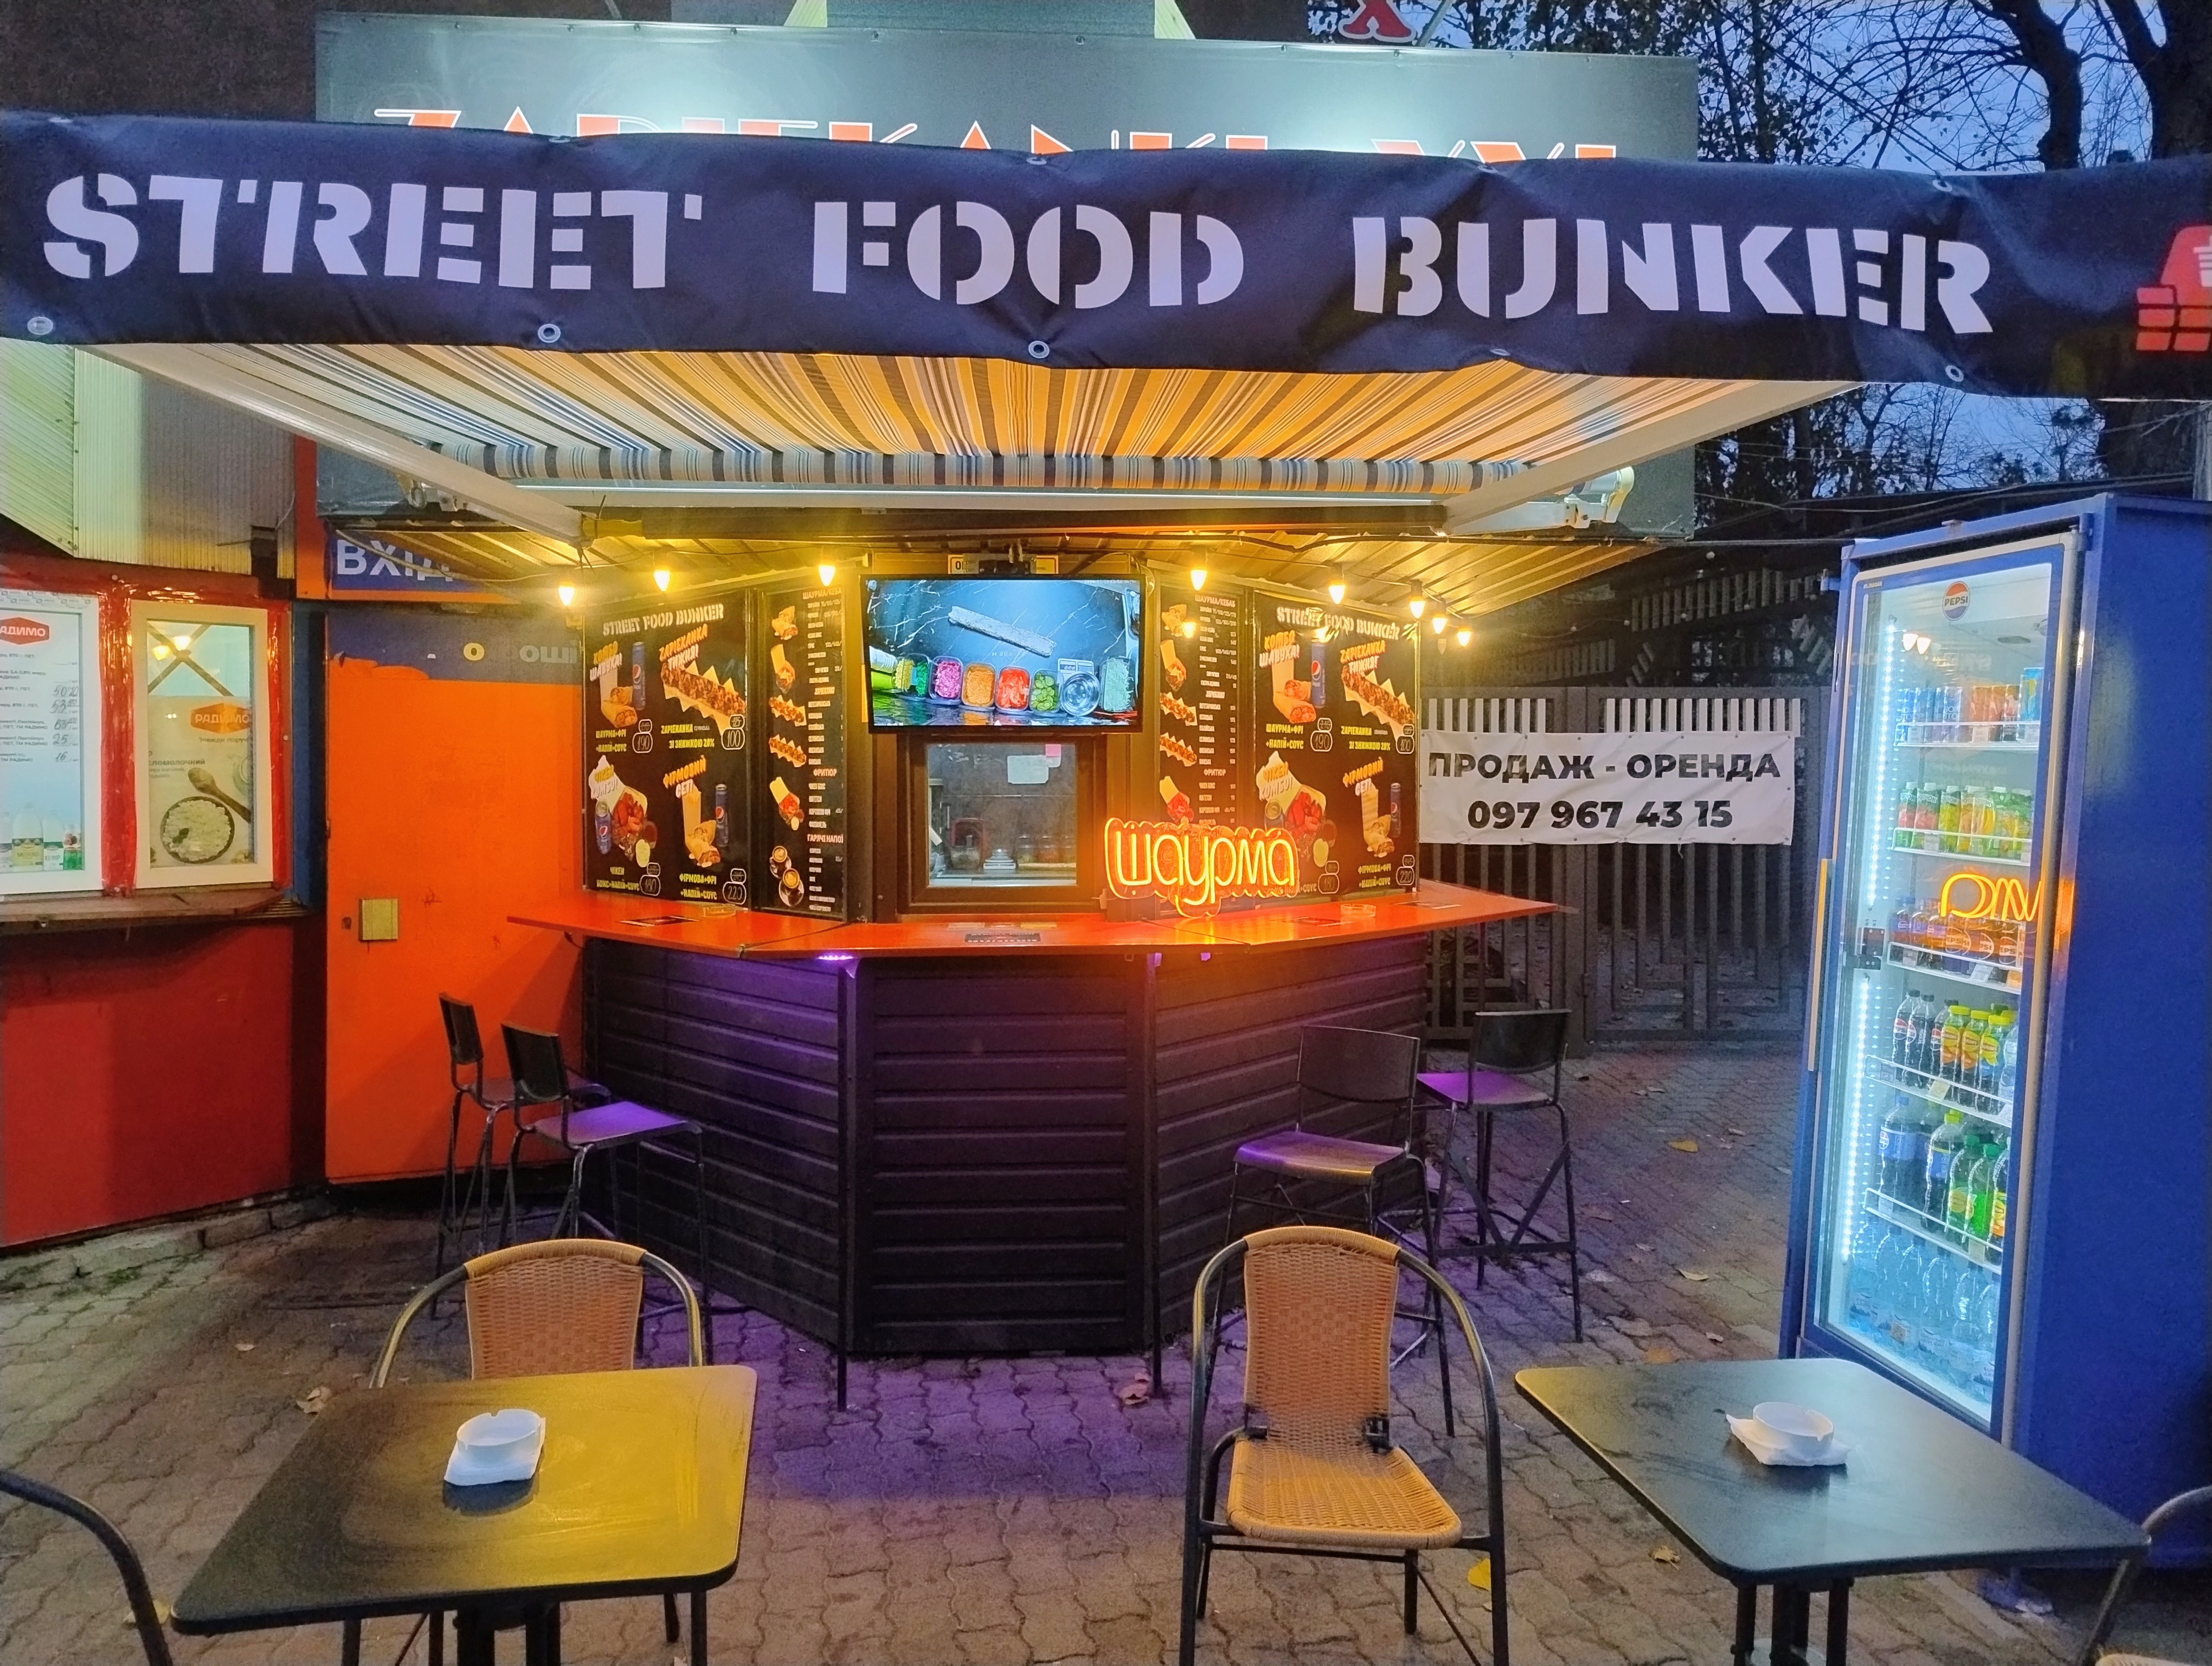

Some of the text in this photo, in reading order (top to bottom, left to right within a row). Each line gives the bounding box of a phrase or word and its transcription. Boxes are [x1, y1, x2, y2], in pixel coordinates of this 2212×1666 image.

[43, 172, 1994, 335] STREET FOOD BUNKER
[802, 587, 841, 599] ШАУРМА/КЕБА
[1945, 596, 1968, 607] PEPSI
[603, 604, 724, 636] STREET FOOD BUNKER
[1324, 614, 1354, 631] FOOD
[1356, 618, 1400, 640] BUNKER
[0, 626, 46, 637] АДИМО
[1264, 630, 1295, 650] КОМБО
[1259, 644, 1301, 668] ШАВУХА!
[195, 714, 249, 723] РАДМО
[53, 733, 69, 745] 25
[637, 735, 650, 750] 190
[703, 738, 715, 747] 20%
[727, 730, 741, 747] 100
[1315, 734, 1328, 749] 190
[663, 755, 706, 789] ФІРМОВИЙ
[813, 768, 837, 777] ФРИТЮР
[1204, 768, 1226, 777] ФРИТЮР
[1263, 761, 1289, 783] ЧІКЕН
[1342, 757, 1383, 787] ФІРМОВИЙ
[1427, 753, 1594, 783] ПРОДАЖ
[1626, 753, 1780, 782] ОРЕНДА
[676, 779, 693, 798] СЕТ!
[1259, 776, 1293, 800] КОМБО!
[1355, 778, 1371, 796] СЕТ!
[1468, 800, 1733, 829] 097 967 43 15
[1116, 831, 1295, 906] шаурма
[1400, 870, 1412, 883] 220
[728, 886, 742, 900] 220
[2000, 947, 2016, 957] EPS
